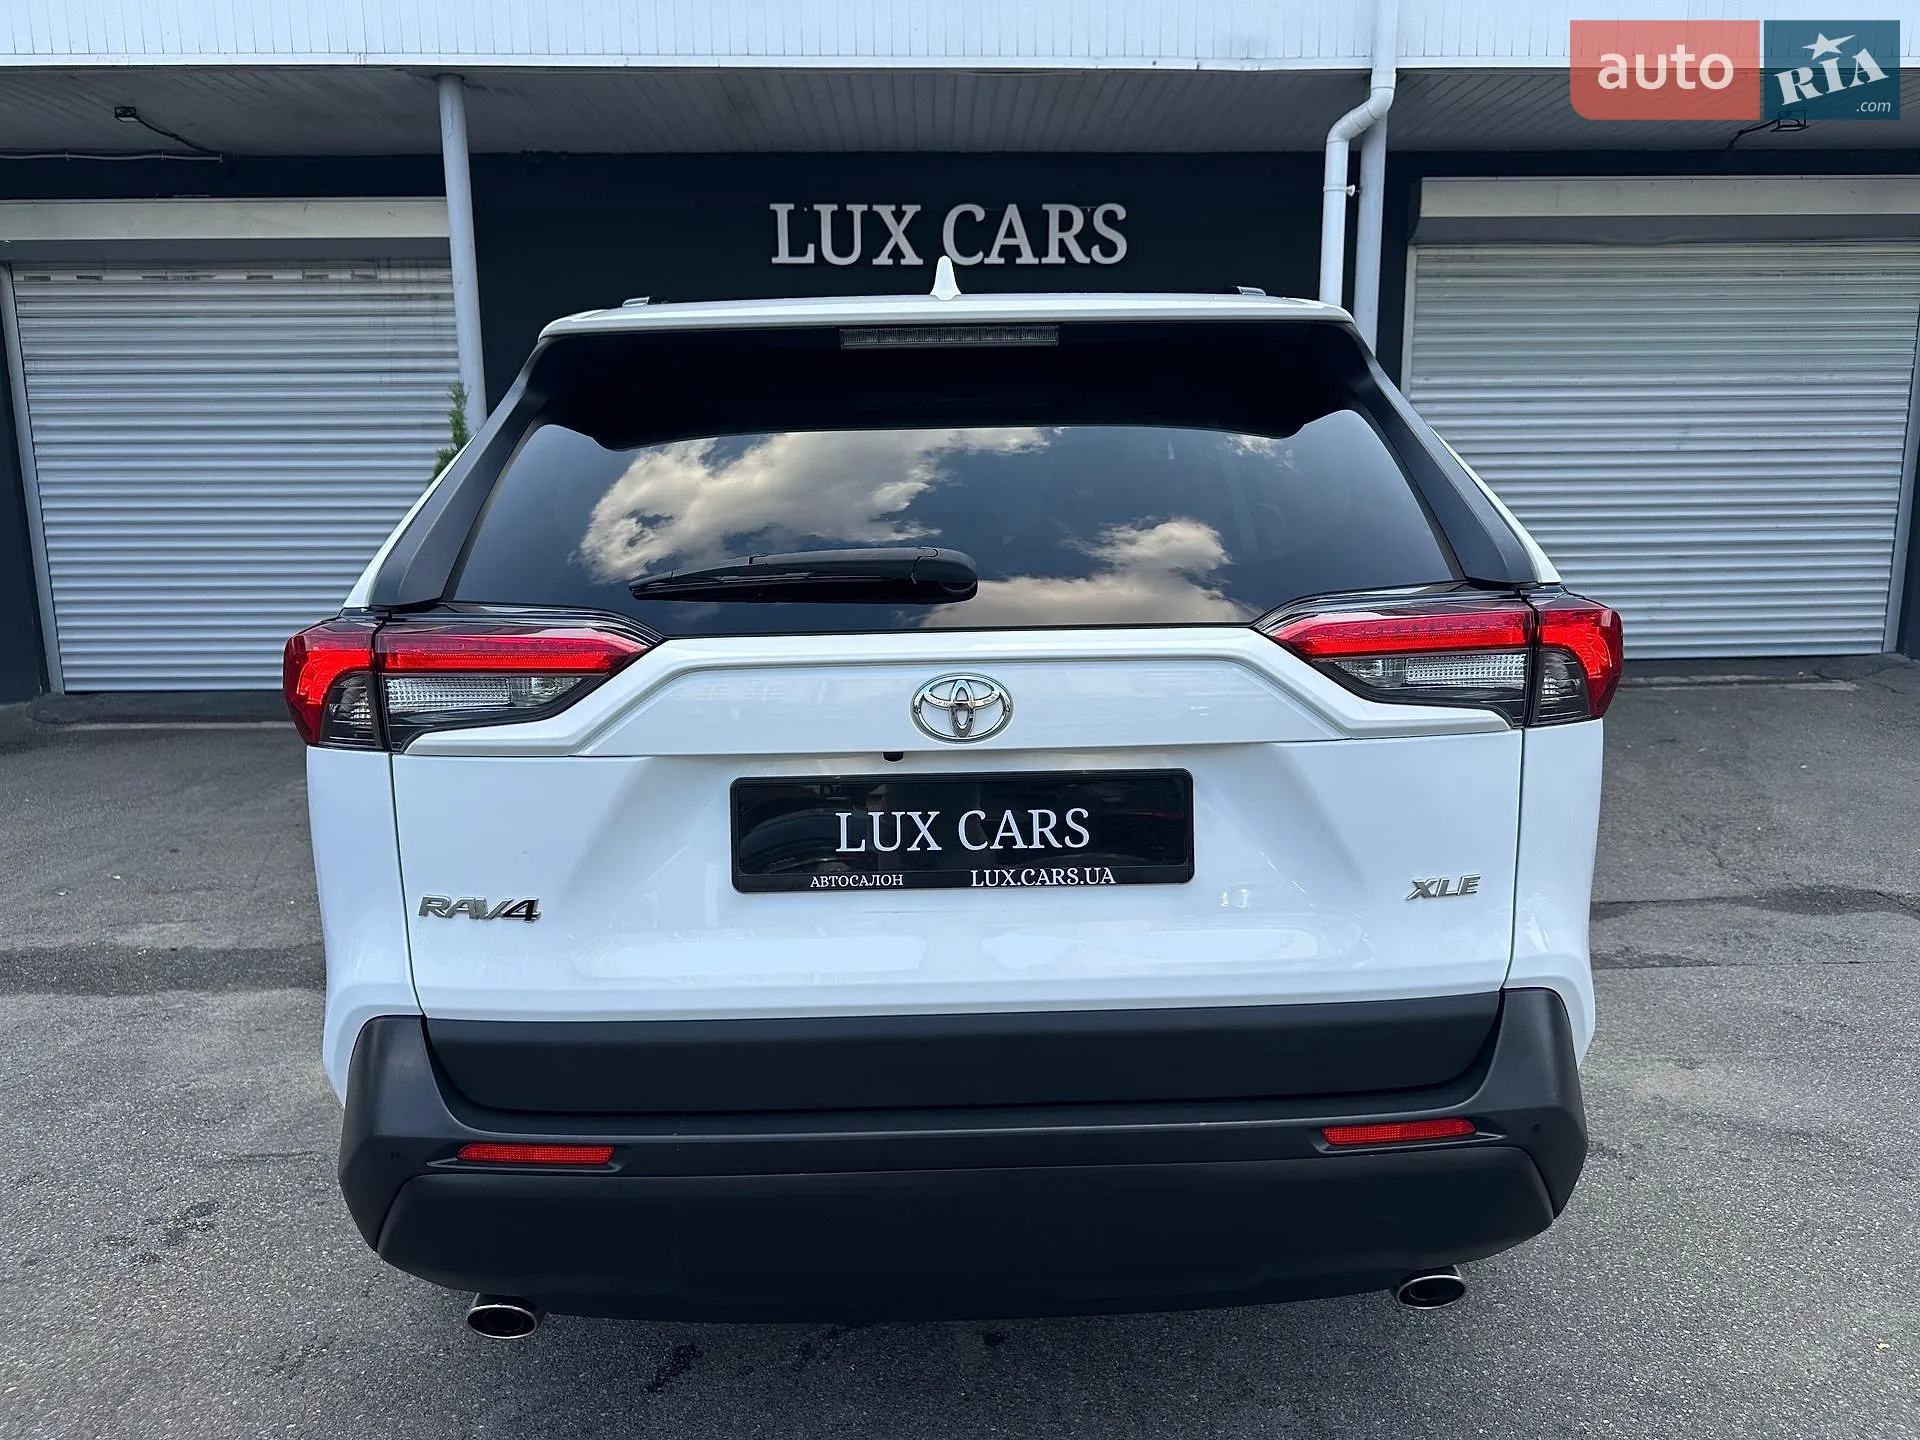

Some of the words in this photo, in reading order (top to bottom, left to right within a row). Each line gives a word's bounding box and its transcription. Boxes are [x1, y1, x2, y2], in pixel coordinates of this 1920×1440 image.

[770, 203, 923, 265] LUX
[942, 203, 1128, 265] CARS
[835, 811, 942, 852] LUX
[958, 807, 1090, 849] CARS
[810, 874, 904, 888] АВТОСАЛОН
[970, 868, 1116, 887] LUX.CARS.UA
[1405, 874, 1481, 901] XLE
[418, 894, 541, 923] RAV4
